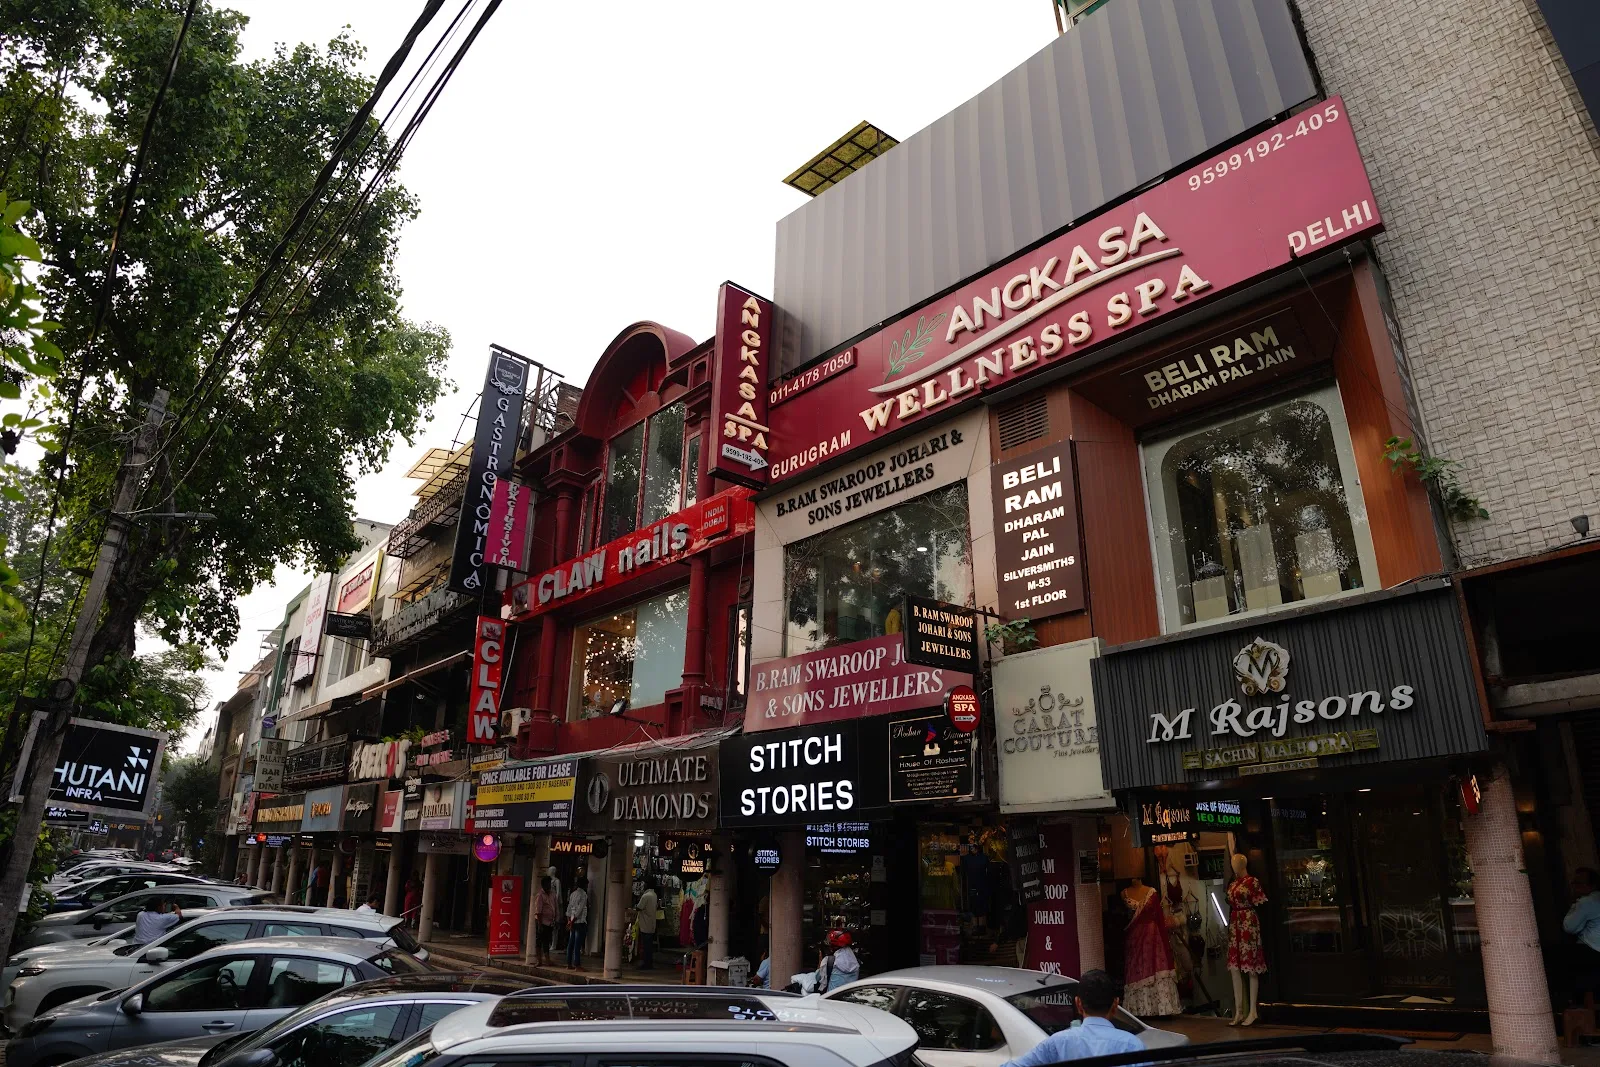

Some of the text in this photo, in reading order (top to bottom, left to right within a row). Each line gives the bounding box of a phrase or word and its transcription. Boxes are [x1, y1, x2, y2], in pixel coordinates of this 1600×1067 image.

[1188, 105, 1340, 191] 9599192-405
[1288, 200, 1373, 254] DELHI
[944, 211, 1168, 344] ANGKASA
[739, 296, 761, 421] ANGKASA
[858, 264, 1213, 434] WELLNESS SPA
[1144, 325, 1280, 393] BELI RAM
[770, 351, 851, 404] 011-4178 7050
[1147, 345, 1297, 410] DHARAM PAL JAIN
[724, 421, 768, 450] SPA
[771, 430, 851, 479] GURUGRAM
[776, 429, 964, 517] B.RAM SWAROOP JOHARI &
[1002, 456, 1061, 490] BELI
[808, 463, 935, 525] SONS JEWELLERS
[1004, 481, 1063, 514] RAM
[704, 515, 726, 530] DUBAI
[705, 504, 724, 519] INDIA
[1004, 506, 1065, 533] DHARAM
[1022, 527, 1049, 543] PAL
[537, 522, 689, 604] CLAW nails
[1021, 543, 1054, 561] JAIN
[1003, 556, 1075, 581] SILVERSMITHS
[1027, 577, 1051, 591] M-53
[1014, 589, 1067, 610] 1st FLOOR
[918, 621, 972, 643] JOHARI & SONS
[922, 607, 939, 621] RAM
[940, 609, 974, 628] SWAROOP
[920, 640, 972, 660] JEWELLERS
[756, 663, 801, 692] B.RAM
[805, 646, 887, 683] SWAROOP
[473, 641, 500, 740] CLAW
[765, 668, 945, 719] & SONS JEWELLERS
[954, 703, 975, 712] SPA
[1013, 709, 1085, 735] CARAT
[1146, 685, 1414, 744] M Rajsons
[750, 733, 842, 773] STITCH
[1003, 726, 1100, 754] COUTURE
[1204, 735, 1349, 766] SACHIN MALHOTRA
[54, 761, 146, 795] HUTANI
[262, 768, 280, 776] BAR
[481, 762, 571, 785] SPACE AVAILABLE FOR LEASE
[617, 754, 708, 788] ULTIMATE
[66, 786, 102, 801] INFRA
[613, 791, 710, 821] DIAMONDS
[741, 779, 854, 817] STORIES
[1217, 814, 1242, 825] LOOK
[806, 836, 870, 848] STITCH STORIES
[755, 856, 780, 864] STORIES
[499, 896, 512, 939] CLAW
[1034, 910, 1065, 925] JOHARI
[1045, 936, 1053, 951] &
[1040, 962, 1061, 975] SONS
